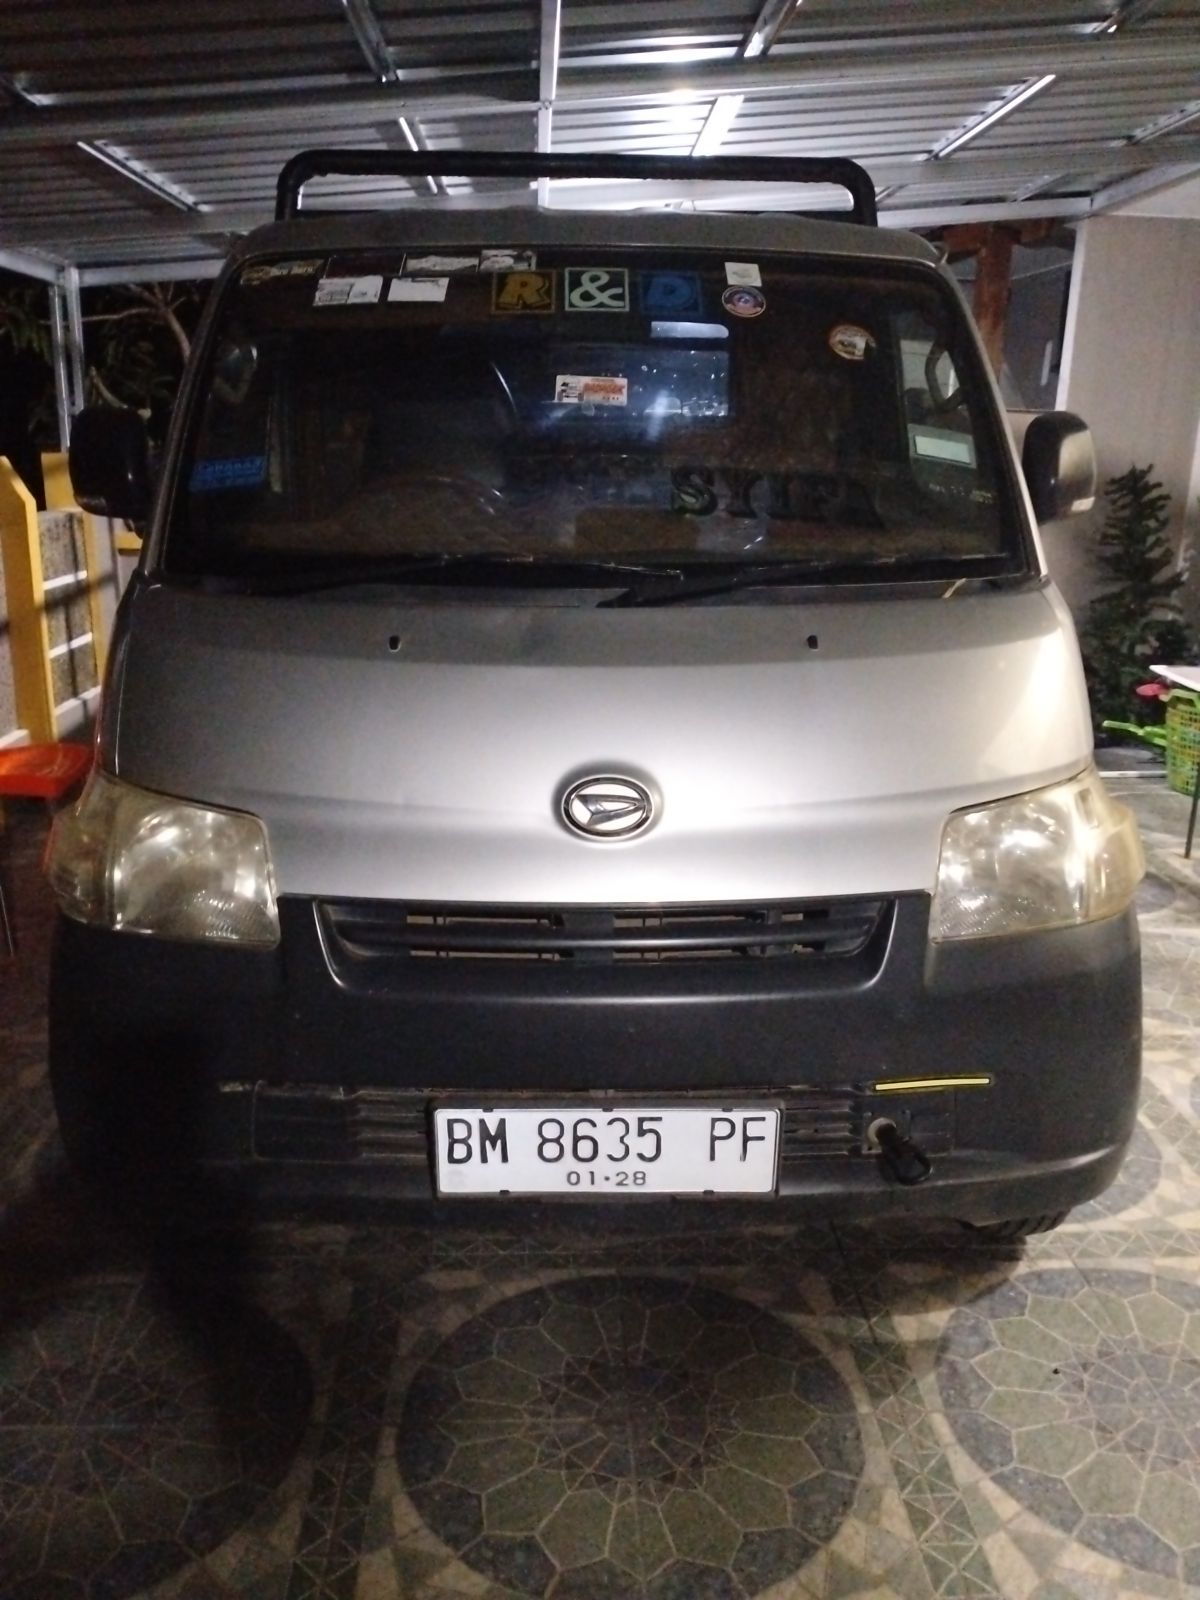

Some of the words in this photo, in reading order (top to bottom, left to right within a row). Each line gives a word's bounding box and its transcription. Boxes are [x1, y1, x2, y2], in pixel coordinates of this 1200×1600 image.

[499, 272, 548, 309] R
[569, 270, 625, 309] &
[647, 276, 694, 309] D
[446, 1117, 509, 1164] BM
[537, 1117, 663, 1163] 8635
[709, 1116, 767, 1162] PF
